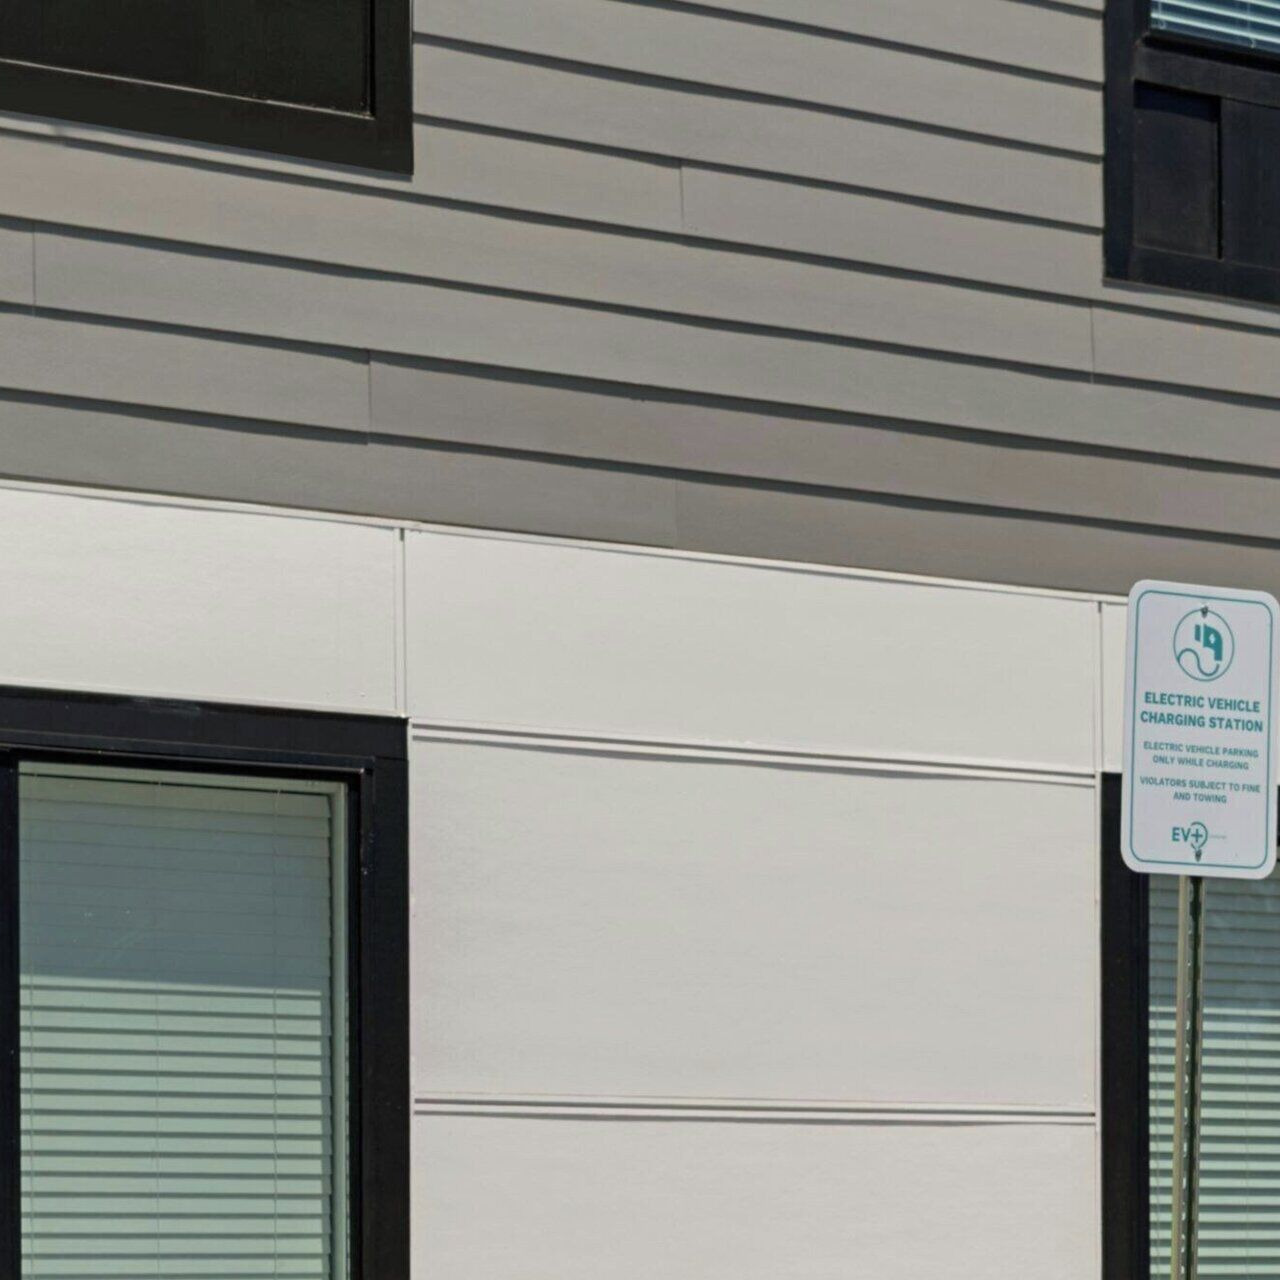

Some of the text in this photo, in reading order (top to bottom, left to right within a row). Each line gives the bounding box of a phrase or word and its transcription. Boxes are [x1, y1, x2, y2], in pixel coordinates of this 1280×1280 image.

[1144, 691, 1261, 713] ELECTRIC VEHICLE
[1140, 710, 1263, 732] CHARGING STATION
[1143, 741, 1259, 758] ELECTRIC VEHICLE PARKING
[1152, 755, 1249, 770] ONLY WHILE CHARGING
[1139, 776, 1261, 793] VIOLATORS SUBJECT TO FINE
[1173, 791, 1227, 804] AND TOWING
